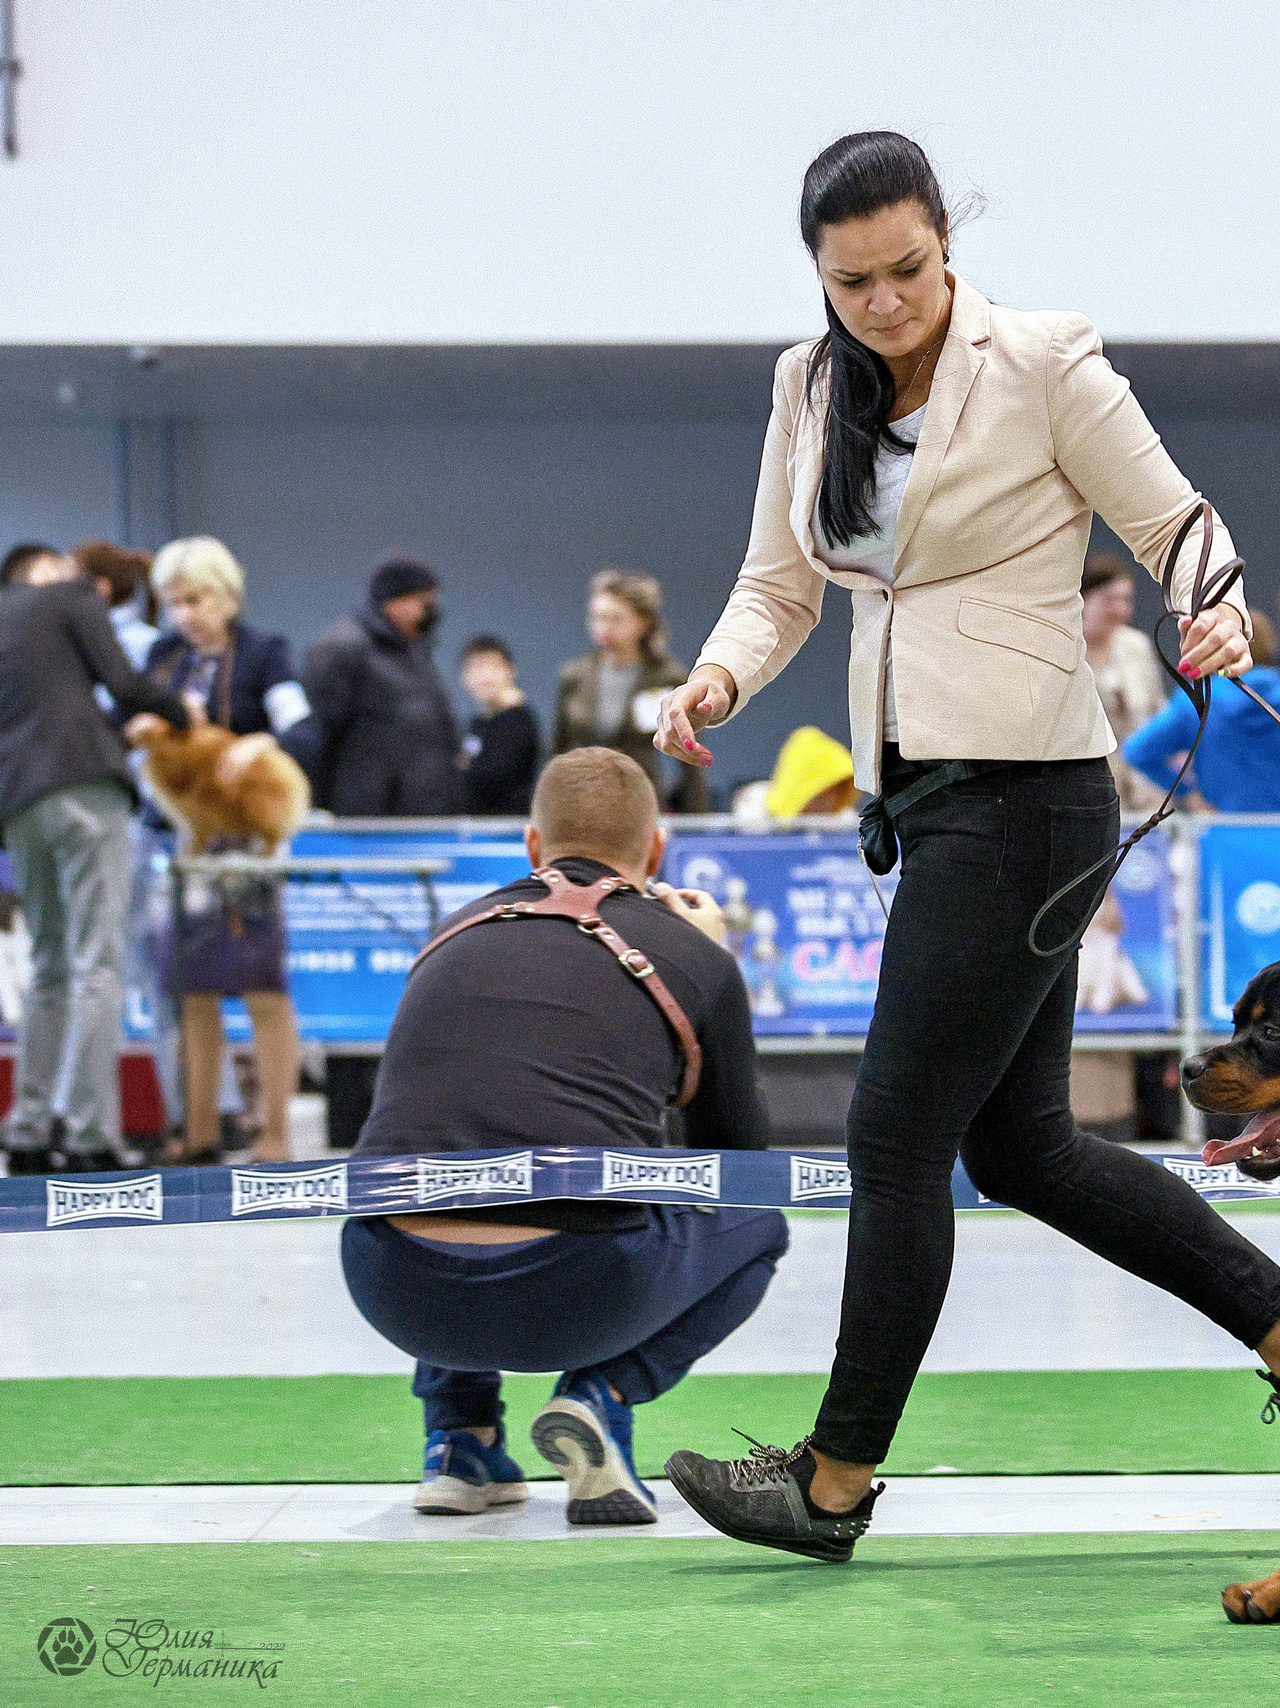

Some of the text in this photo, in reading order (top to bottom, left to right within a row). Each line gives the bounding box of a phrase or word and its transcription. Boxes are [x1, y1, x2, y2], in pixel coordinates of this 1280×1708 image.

[423, 1168, 484, 1192] HAPPY
[611, 1161, 713, 1188] HAPPY DOG
[798, 1166, 850, 1191] HAPP
[54, 1185, 156, 1217] HAPPY DOG
[239, 1175, 340, 1205] HAPPY DOG
